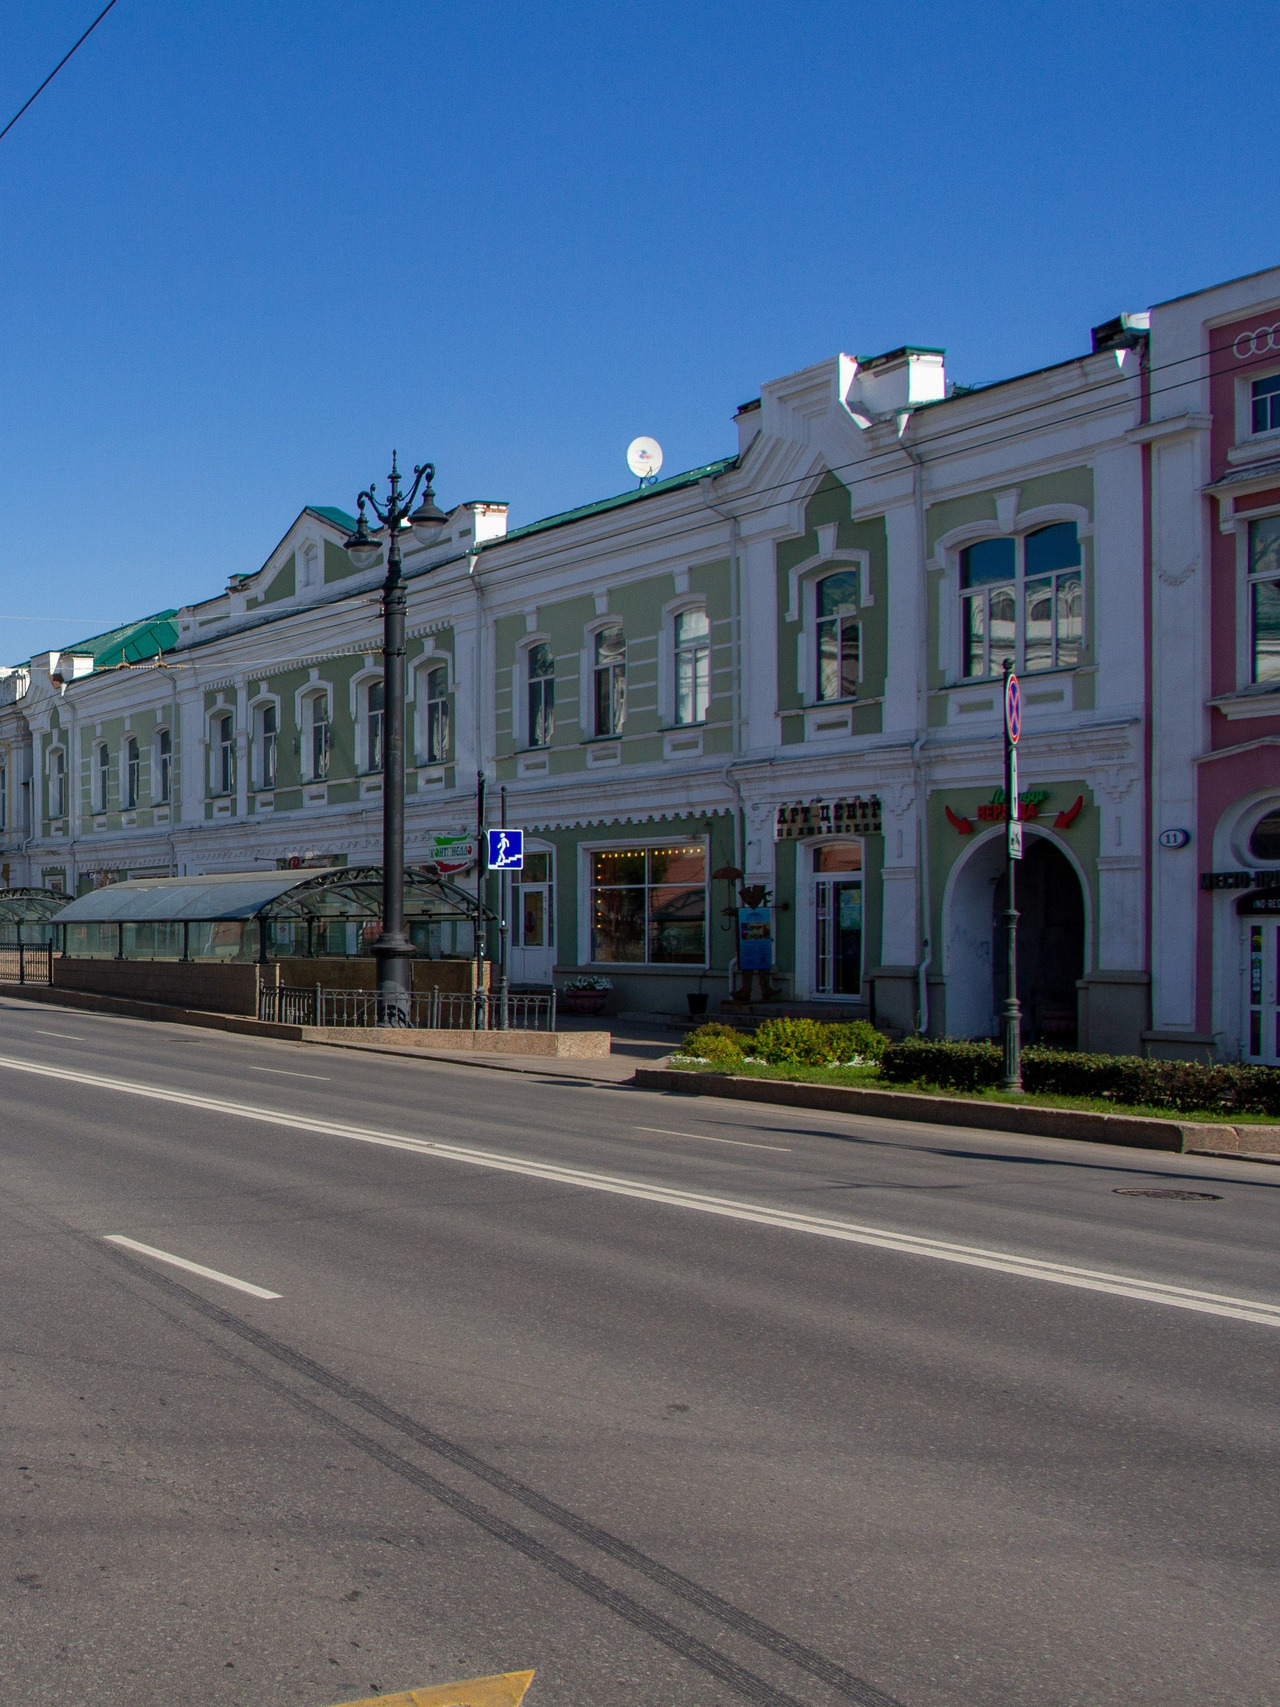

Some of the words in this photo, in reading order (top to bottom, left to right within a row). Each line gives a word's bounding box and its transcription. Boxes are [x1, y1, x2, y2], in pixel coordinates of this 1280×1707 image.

[777, 801, 881, 824] АРТ-ЦЕНТР
[977, 802, 1039, 821] ВЕРДА
[1165, 833, 1179, 844] 11
